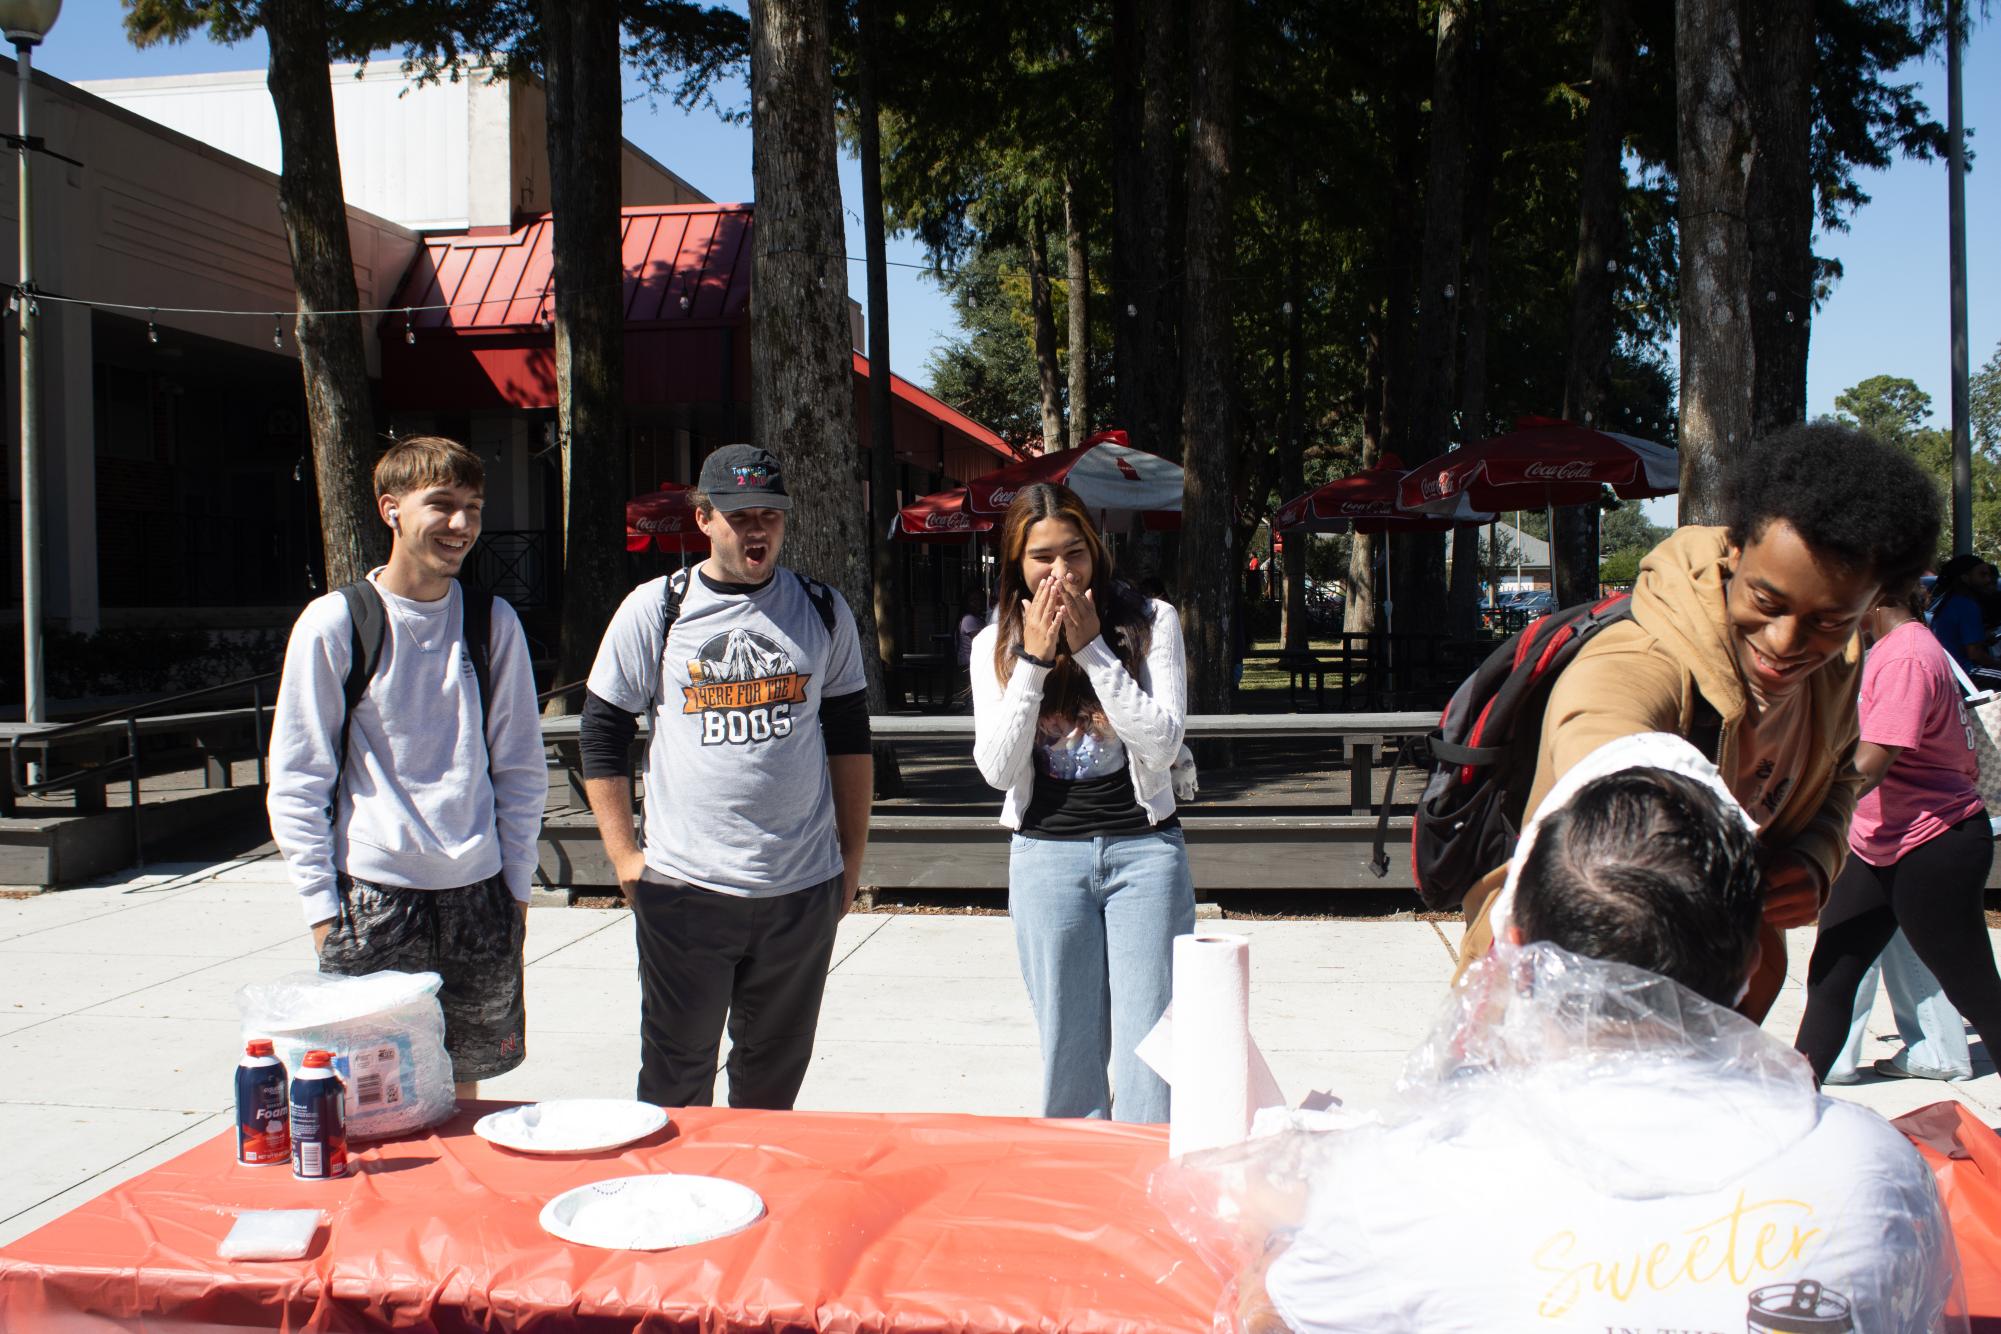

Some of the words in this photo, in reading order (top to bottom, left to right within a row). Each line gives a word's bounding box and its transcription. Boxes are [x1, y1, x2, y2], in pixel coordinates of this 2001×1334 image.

[699, 685, 734, 706] HERE
[737, 682, 762, 705] FOR
[765, 677, 790, 700] THE
[703, 703, 791, 744] BOOS
[256, 1106, 289, 1120] Foam
[1531, 1187, 1822, 1318] Sweeter
